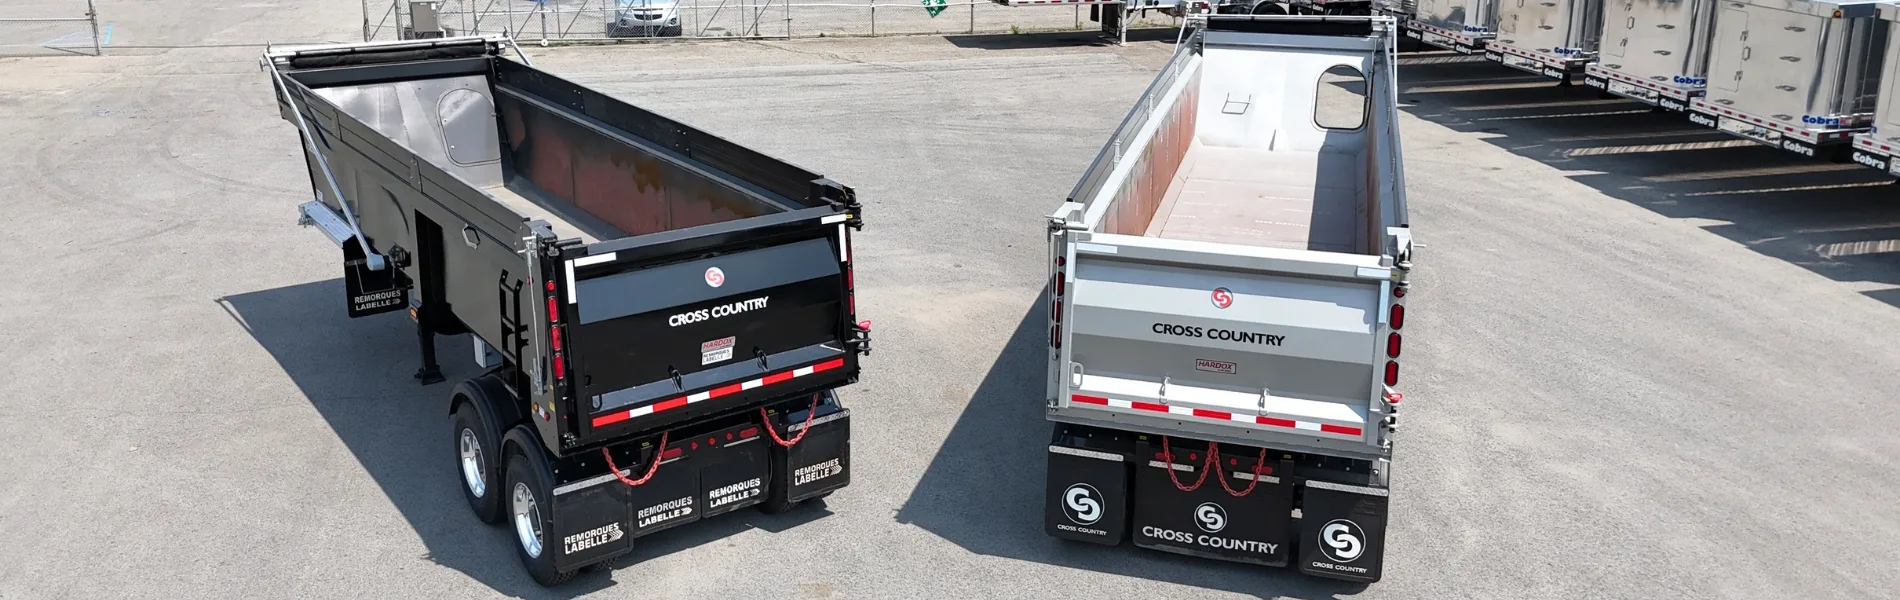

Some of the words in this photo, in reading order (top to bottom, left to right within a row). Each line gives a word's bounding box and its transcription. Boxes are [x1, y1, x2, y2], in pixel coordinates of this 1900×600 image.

[1486, 52, 1502, 62] Cobra
[1554, 47, 1581, 55] Cobra
[1544, 68, 1563, 79] Cobra
[1674, 76, 1706, 85] Cobra
[1585, 77, 1605, 89] Cobra
[1660, 99, 1684, 112] Cobra
[1689, 113, 1715, 127] Cobra
[1802, 115, 1839, 125] Cobra
[1783, 140, 1813, 156] Cobra
[1853, 152, 1885, 169] Cobra
[354, 290, 401, 304] REMORQUES
[355, 299, 391, 311] LABELLE
[669, 309, 709, 326] CROSS
[711, 296, 769, 317] COUNTRY
[1152, 323, 1202, 338] CROSS
[1207, 328, 1286, 346] COUNTRY
[703, 338, 733, 349] HARDOX
[1198, 360, 1233, 370] HARDOX
[794, 457, 839, 477] REMORQUES
[794, 468, 830, 486] LABELLE
[709, 478, 761, 499] REMORQUES
[710, 490, 749, 508] LABELLE
[638, 496, 693, 519] REMORQUES
[638, 510, 681, 528] LABELLE
[564, 522, 620, 545] REMORQUES
[1057, 524, 1077, 532] CROSS
[1077, 527, 1107, 536] COUNTRY
[564, 534, 608, 555] LABELLE
[1142, 525, 1193, 543] CROSS
[1197, 535, 1279, 554] COUNTRY
[1312, 561, 1334, 569] CROSS
[1334, 564, 1368, 574] COUNTRY
